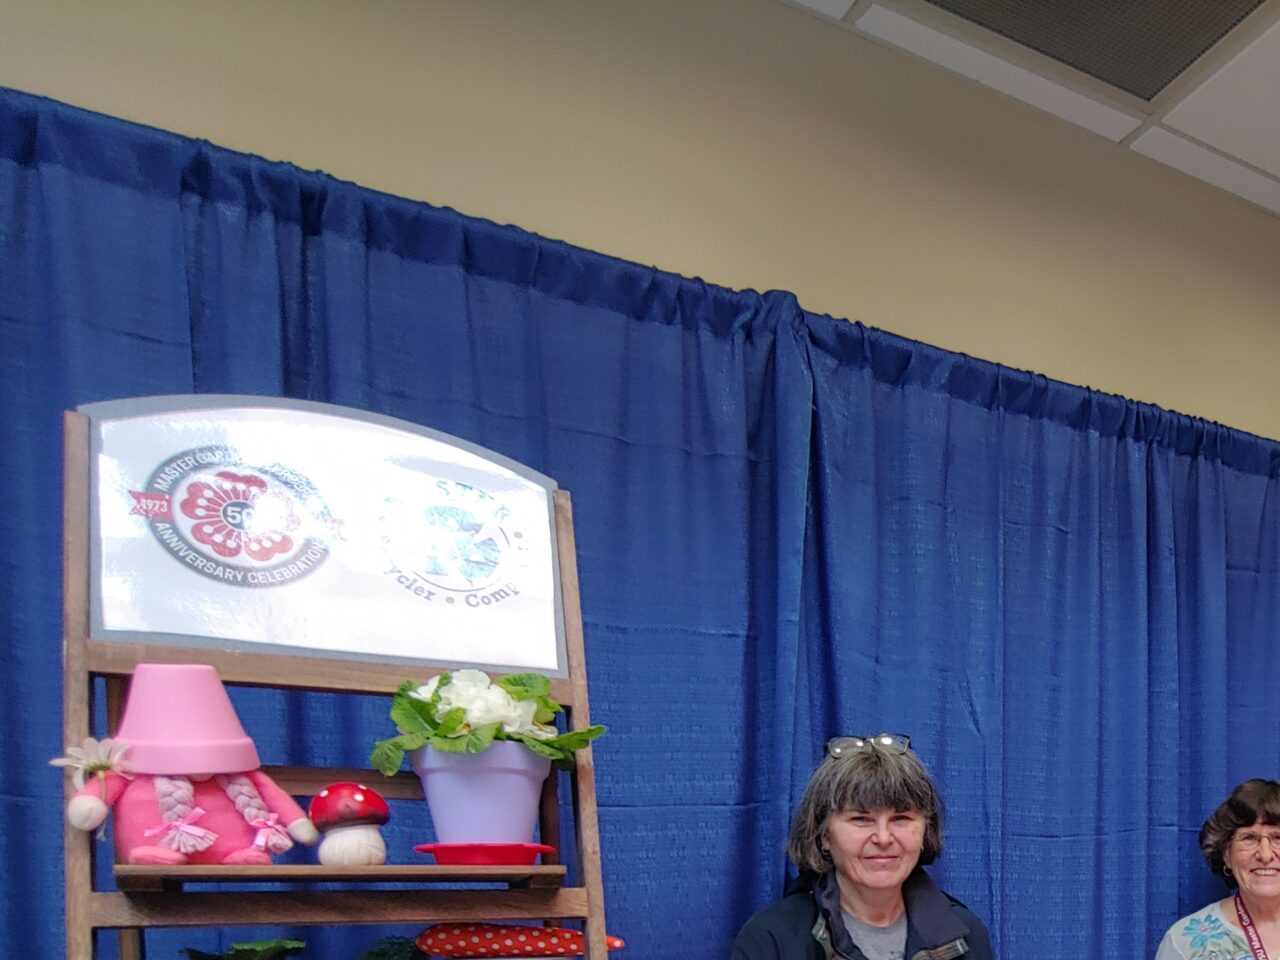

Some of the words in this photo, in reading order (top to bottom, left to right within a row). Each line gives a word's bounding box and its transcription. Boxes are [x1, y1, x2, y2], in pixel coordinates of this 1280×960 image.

[153, 455, 197, 491] MASTER
[155, 521, 244, 582] ANNIVERSARY
[247, 542, 325, 584] CELEBRATION
